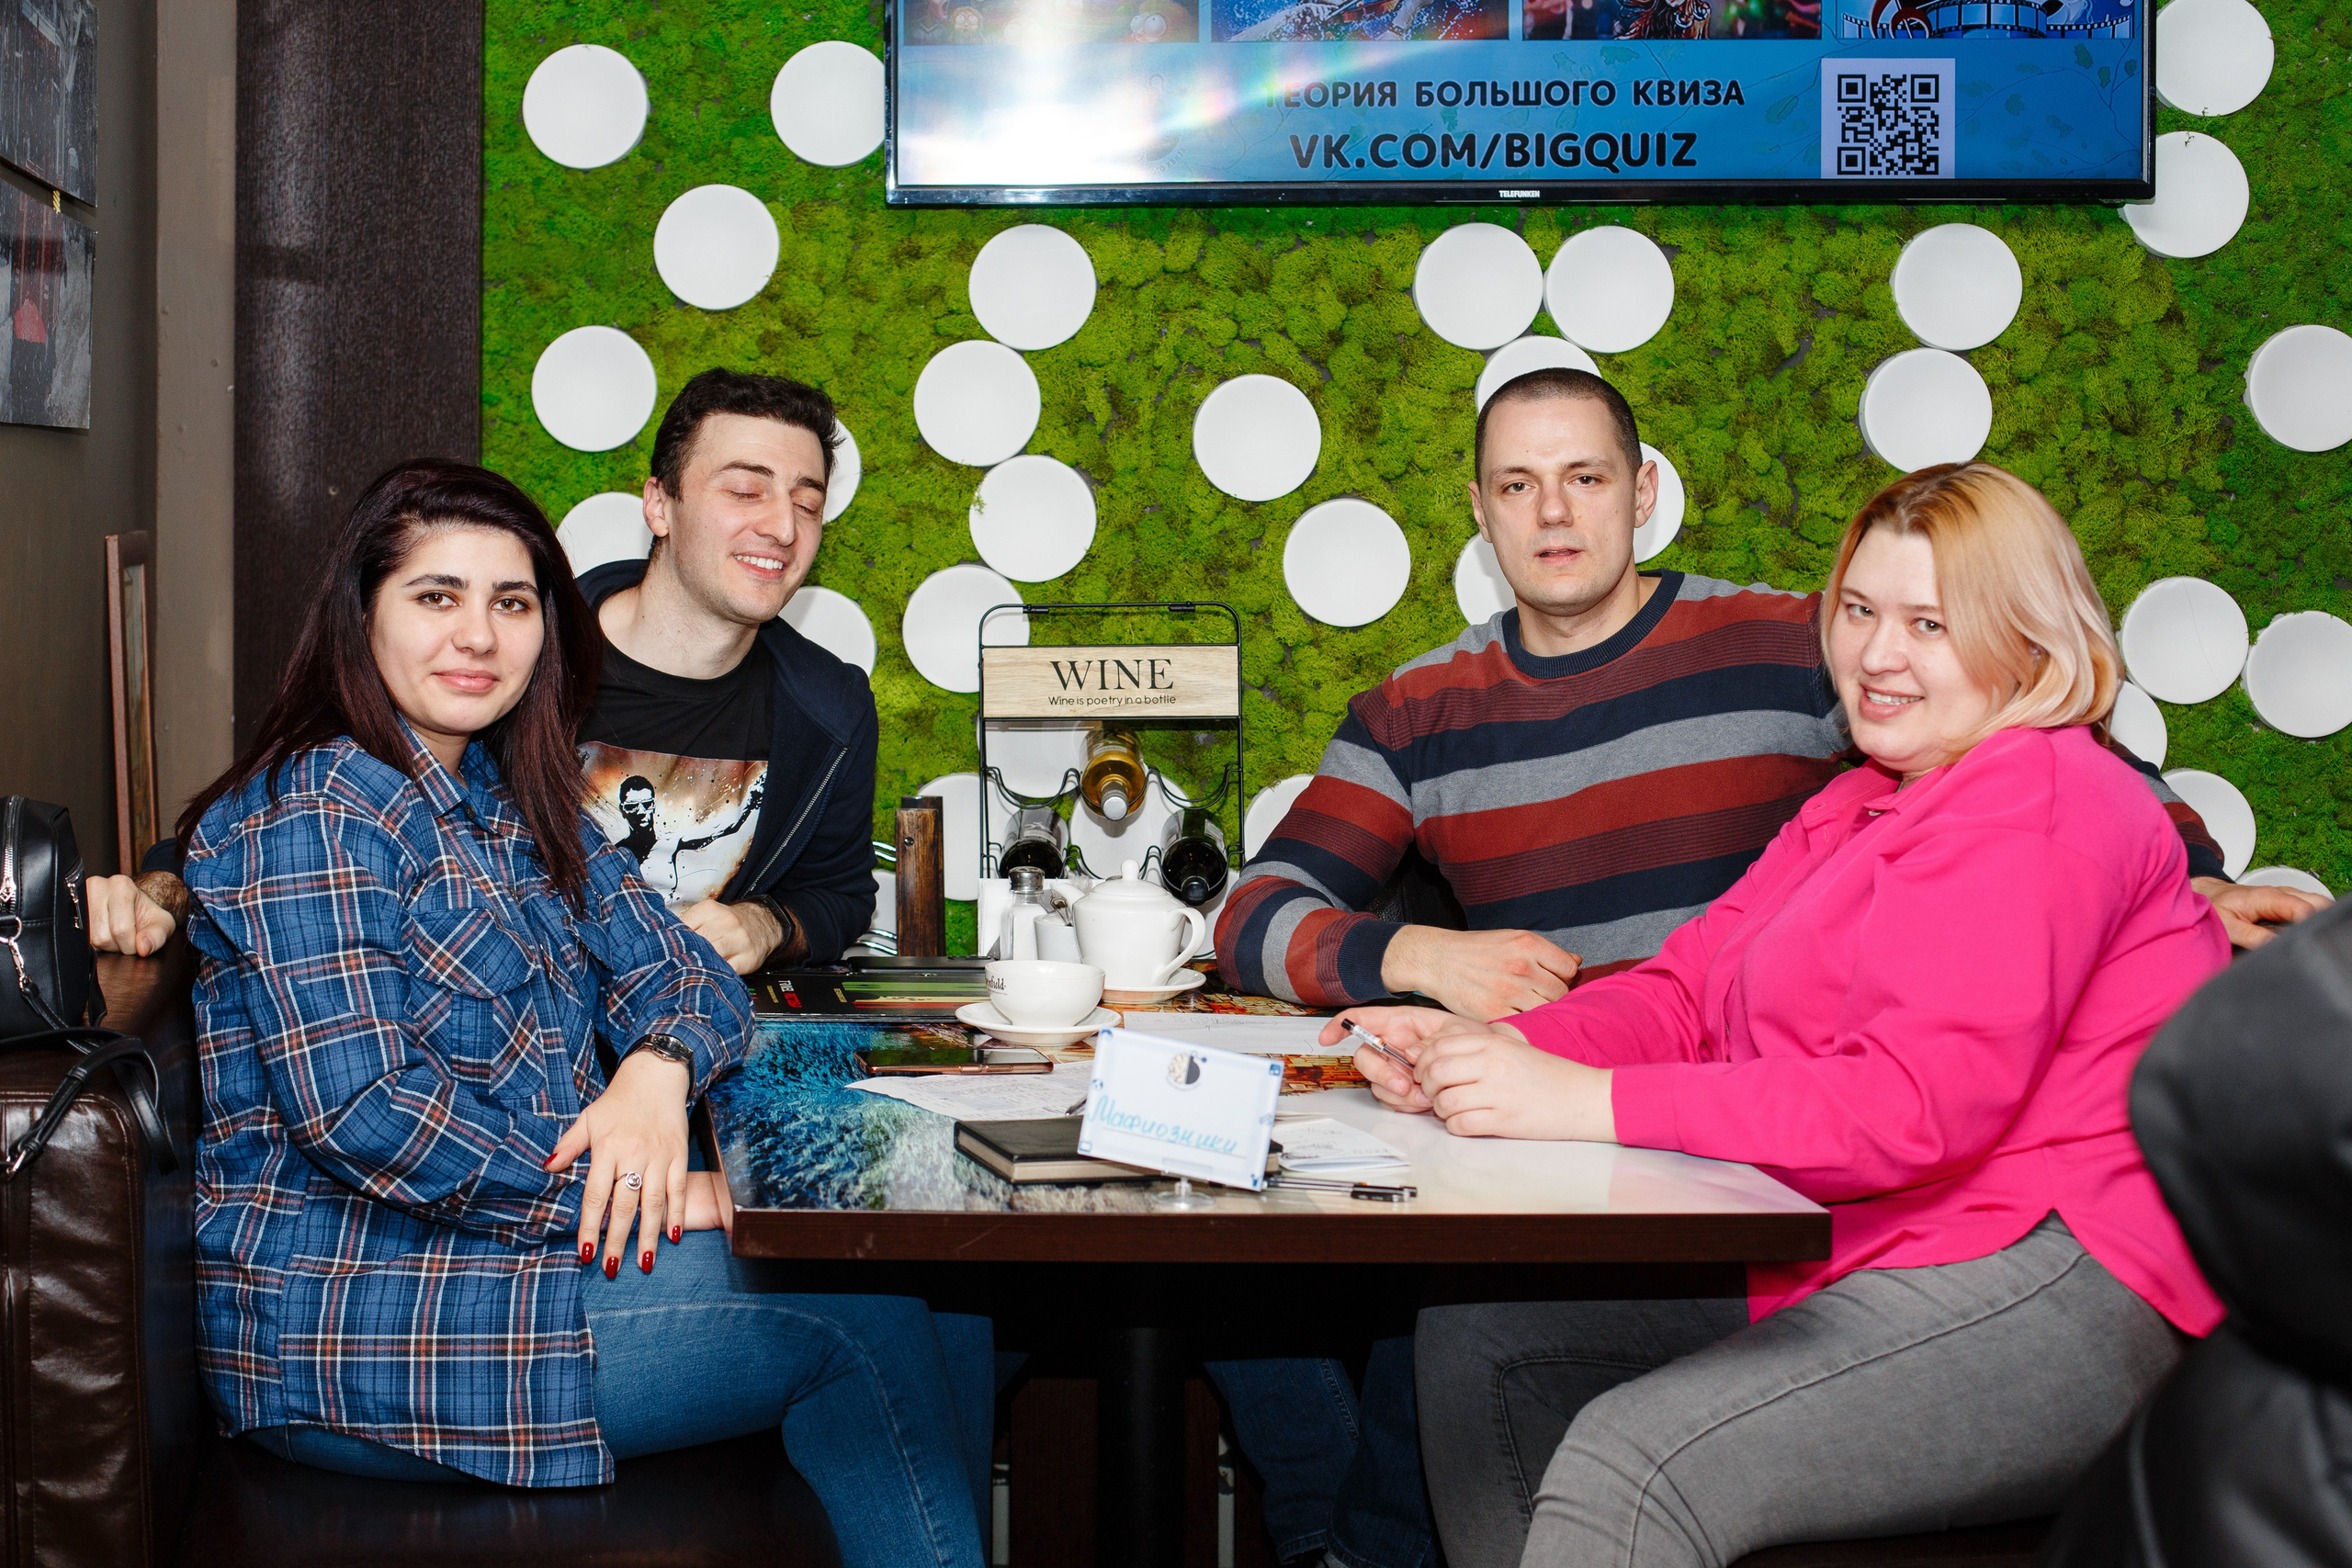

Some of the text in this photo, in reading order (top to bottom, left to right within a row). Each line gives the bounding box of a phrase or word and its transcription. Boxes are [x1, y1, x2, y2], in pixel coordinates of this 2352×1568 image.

[1261, 79, 1746, 108] ТЕОРИЯ БОЛЬШОГО КВИЗА
[1289, 132, 1698, 175] VK.COM/BIGQUIZ
[1498, 189, 1541, 198] TELEFUNKEN
[1049, 659, 1174, 691] WINE
[1048, 695, 1075, 705] Wine
[1076, 695, 1084, 705] is
[1086, 695, 1123, 707] poetry
[1124, 695, 1134, 705] in
[1135, 696, 1142, 705] a
[1087, 1095, 1238, 1154] Мафиозники
